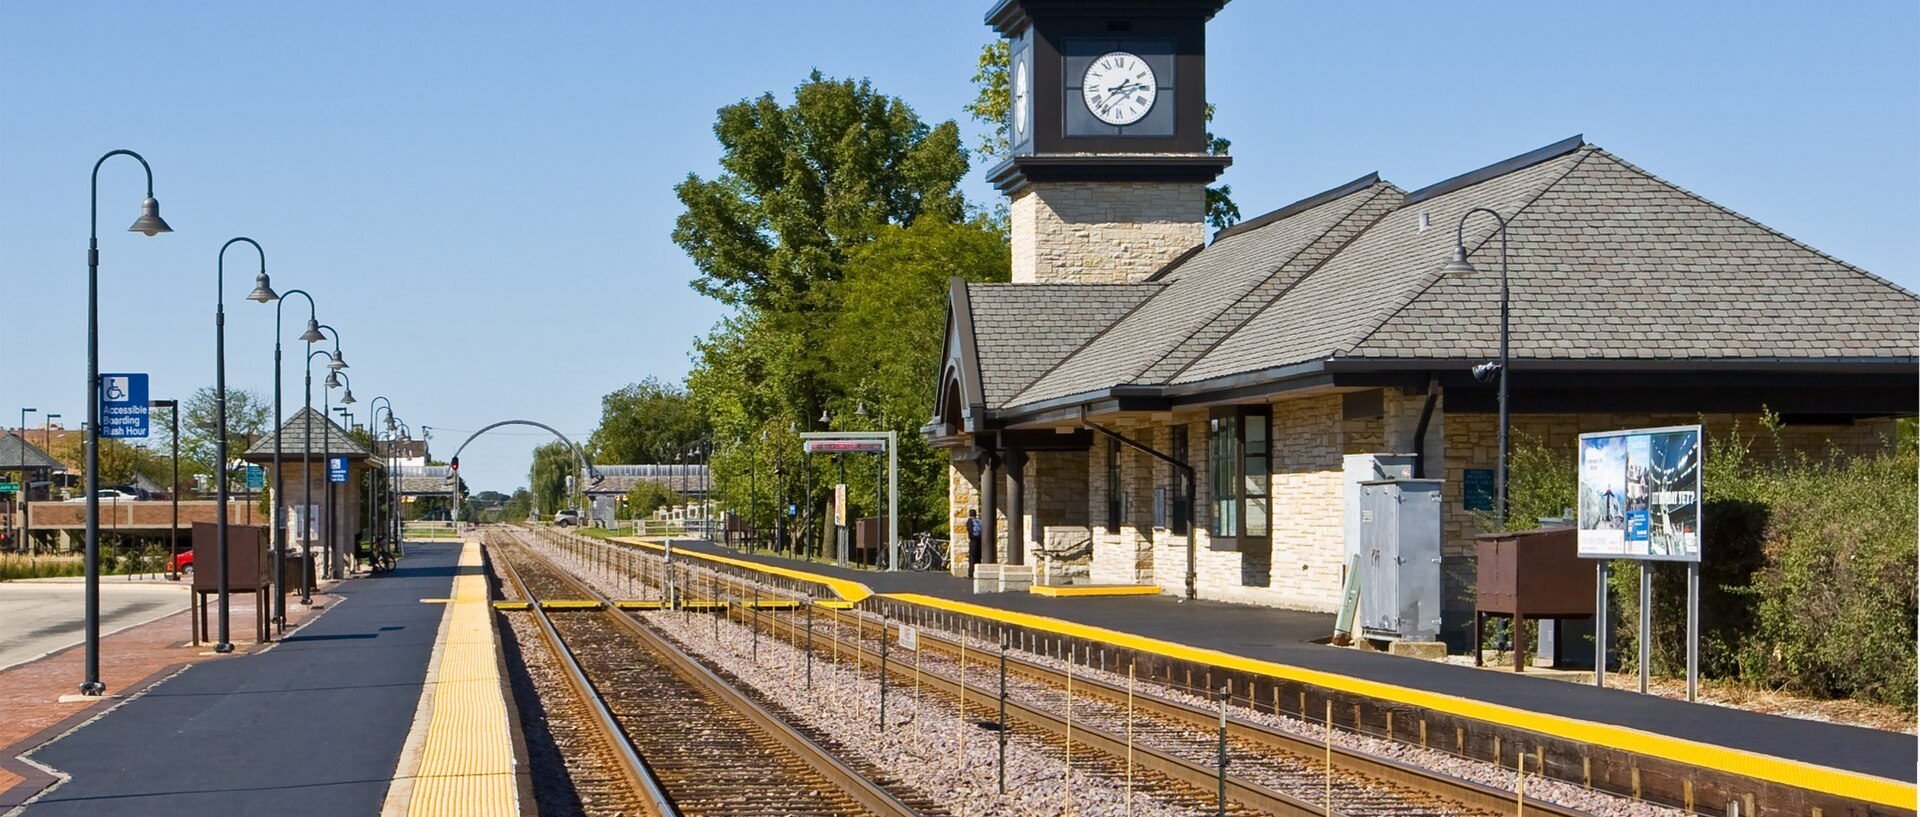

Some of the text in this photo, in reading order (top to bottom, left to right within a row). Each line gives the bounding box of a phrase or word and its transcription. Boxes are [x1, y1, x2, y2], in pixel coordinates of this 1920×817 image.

[103, 405, 147, 415] Accessible
[103, 415, 140, 427] Boarding
[103, 426, 147, 436] Rush Hour
[1678, 491, 1695, 505] YET?
